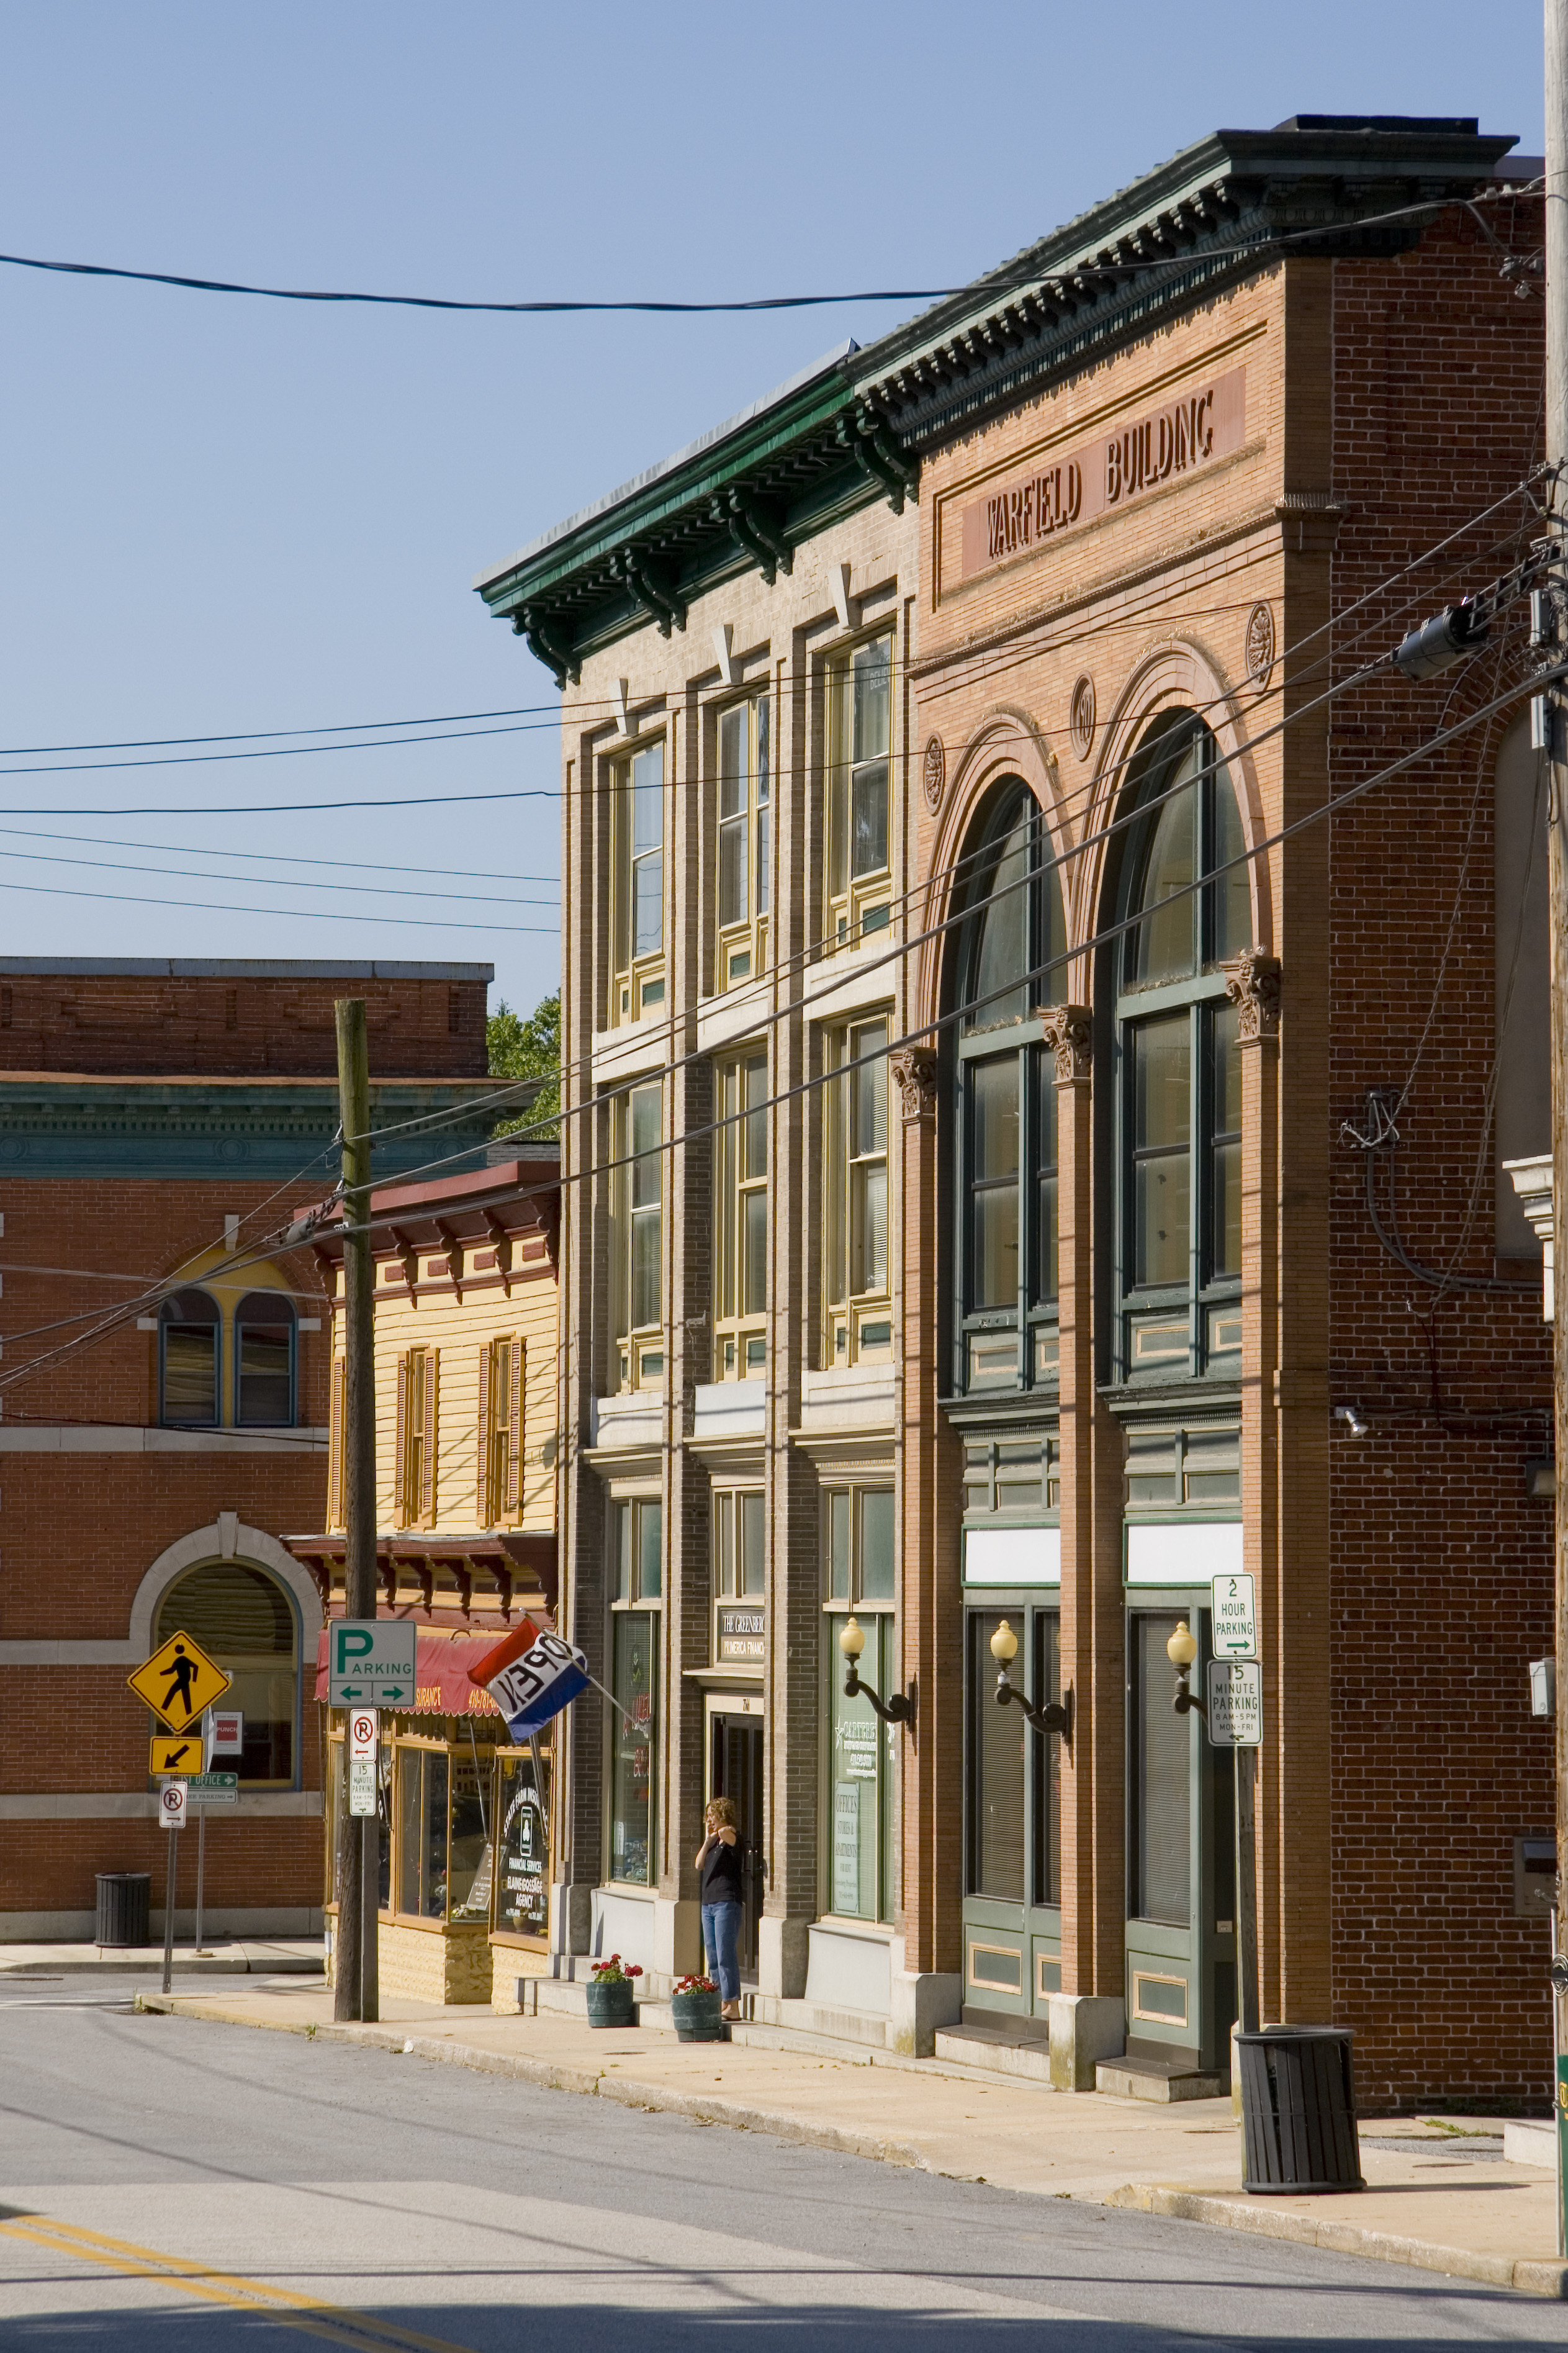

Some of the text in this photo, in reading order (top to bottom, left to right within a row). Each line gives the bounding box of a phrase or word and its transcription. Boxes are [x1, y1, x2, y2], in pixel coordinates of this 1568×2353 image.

[988, 390, 1213, 559] WARFIELD BUILDING
[1229, 1582, 1237, 1597] 2
[1222, 1603, 1245, 1616] HOUR
[723, 1615, 734, 1632] THE
[1217, 1622, 1253, 1635] PARKING
[724, 1641, 765, 1655] PRIMERICA FINANCI
[1227, 1665, 1244, 1680] 15
[415, 1686, 441, 1707] SURANCE
[1215, 1684, 1255, 1694] MINUTE
[1213, 1697, 1258, 1710] PARKING
[359, 1765, 367, 1775] 15
[196, 1774, 221, 1785] OFFICE
[352, 1785, 374, 1794] PARKING
[836, 1794, 857, 1813] OFFICES
[503, 1787, 548, 1838] STATE FARM INSUNCE
[837, 1821, 850, 1835] STORES
[835, 1843, 857, 1858] APARTMENTS
[509, 1857, 542, 1873] FINANCIAL SERVICES
[507, 1876, 543, 1894] ELAINE GOSSAGE
[516, 1892, 533, 1908] AGENCY
